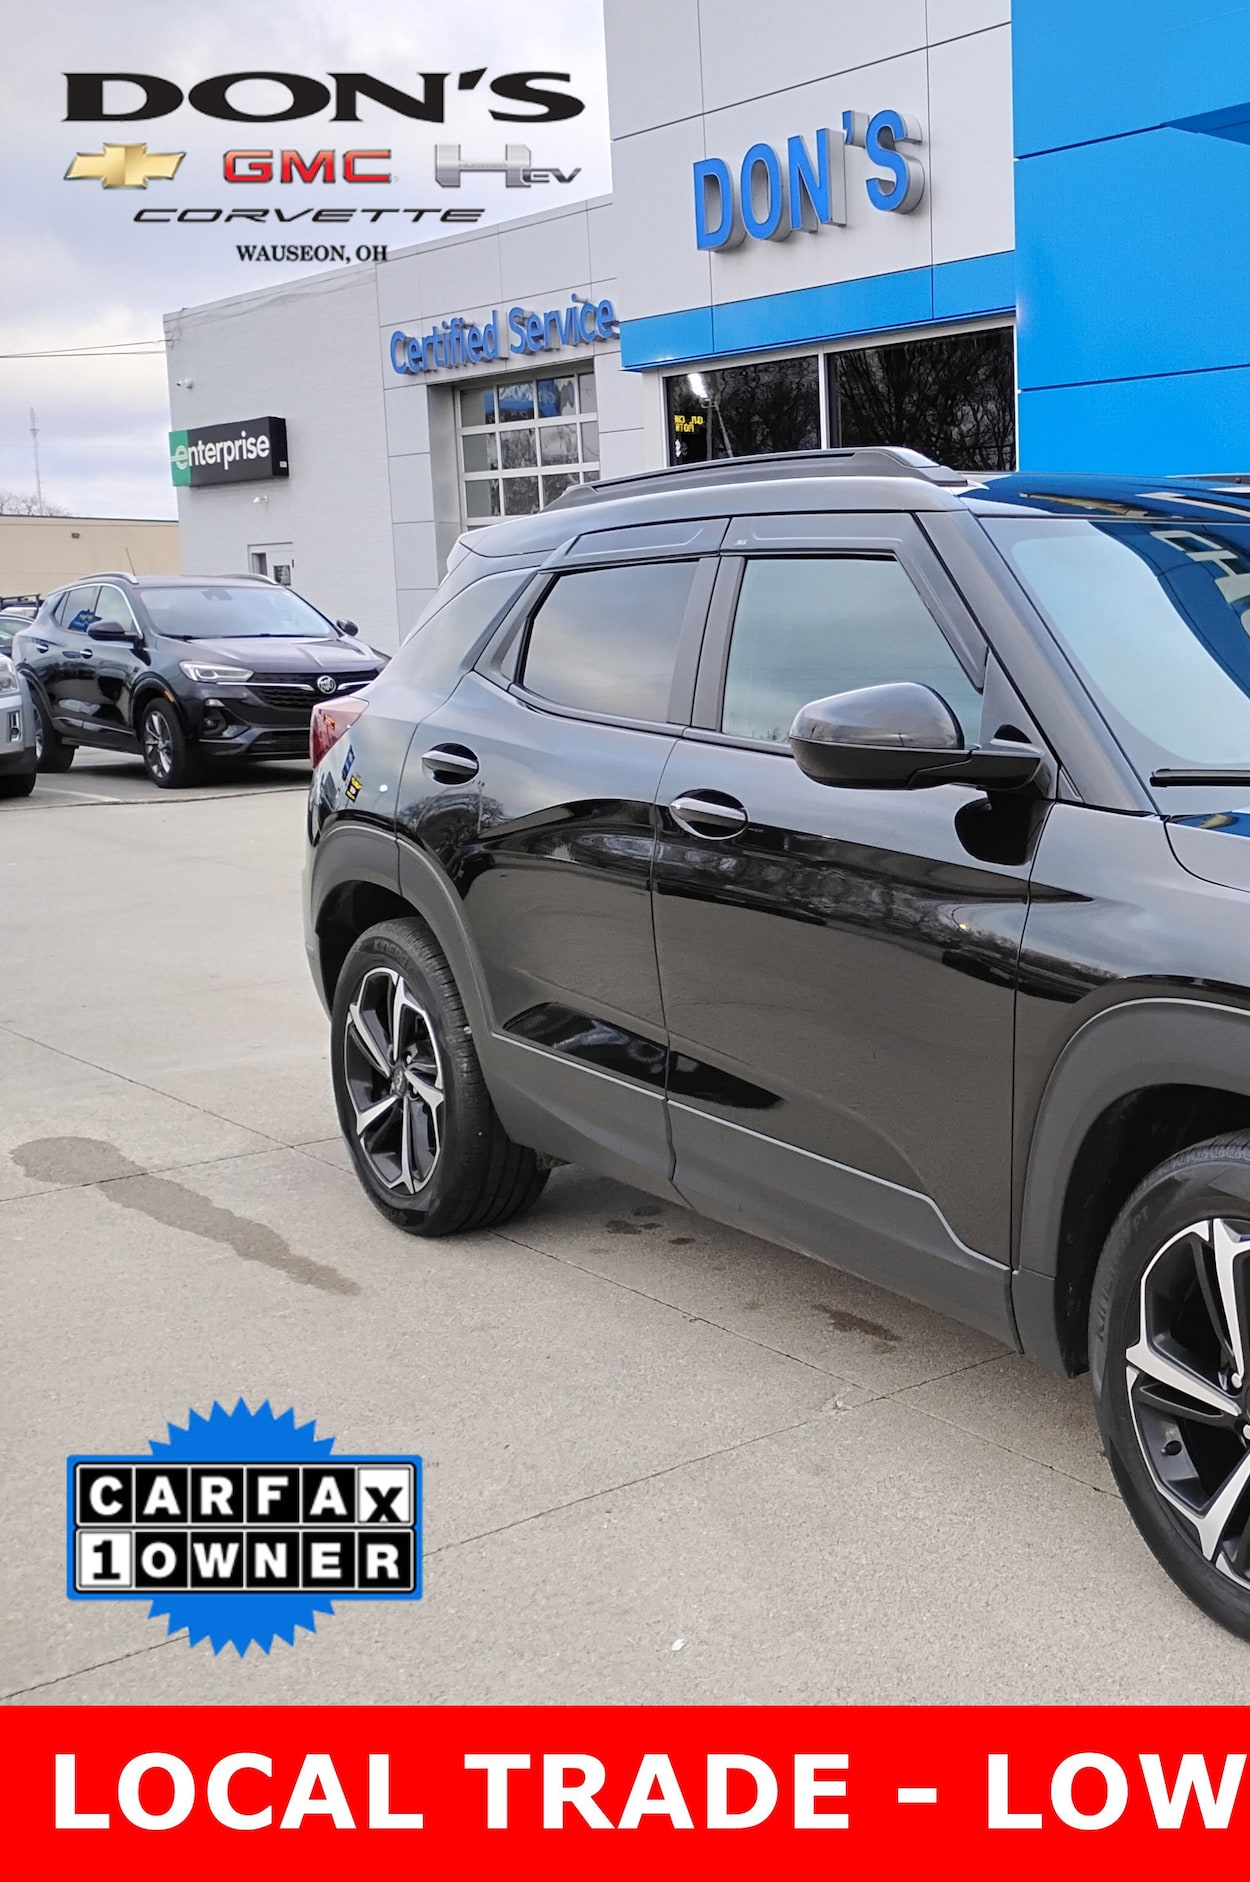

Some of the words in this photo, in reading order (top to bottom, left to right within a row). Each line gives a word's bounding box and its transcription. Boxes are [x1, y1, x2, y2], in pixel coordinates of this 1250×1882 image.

[693, 109, 924, 251] DON'S
[390, 309, 501, 374] Certified
[508, 293, 616, 355] Service
[173, 430, 270, 470] enterprise
